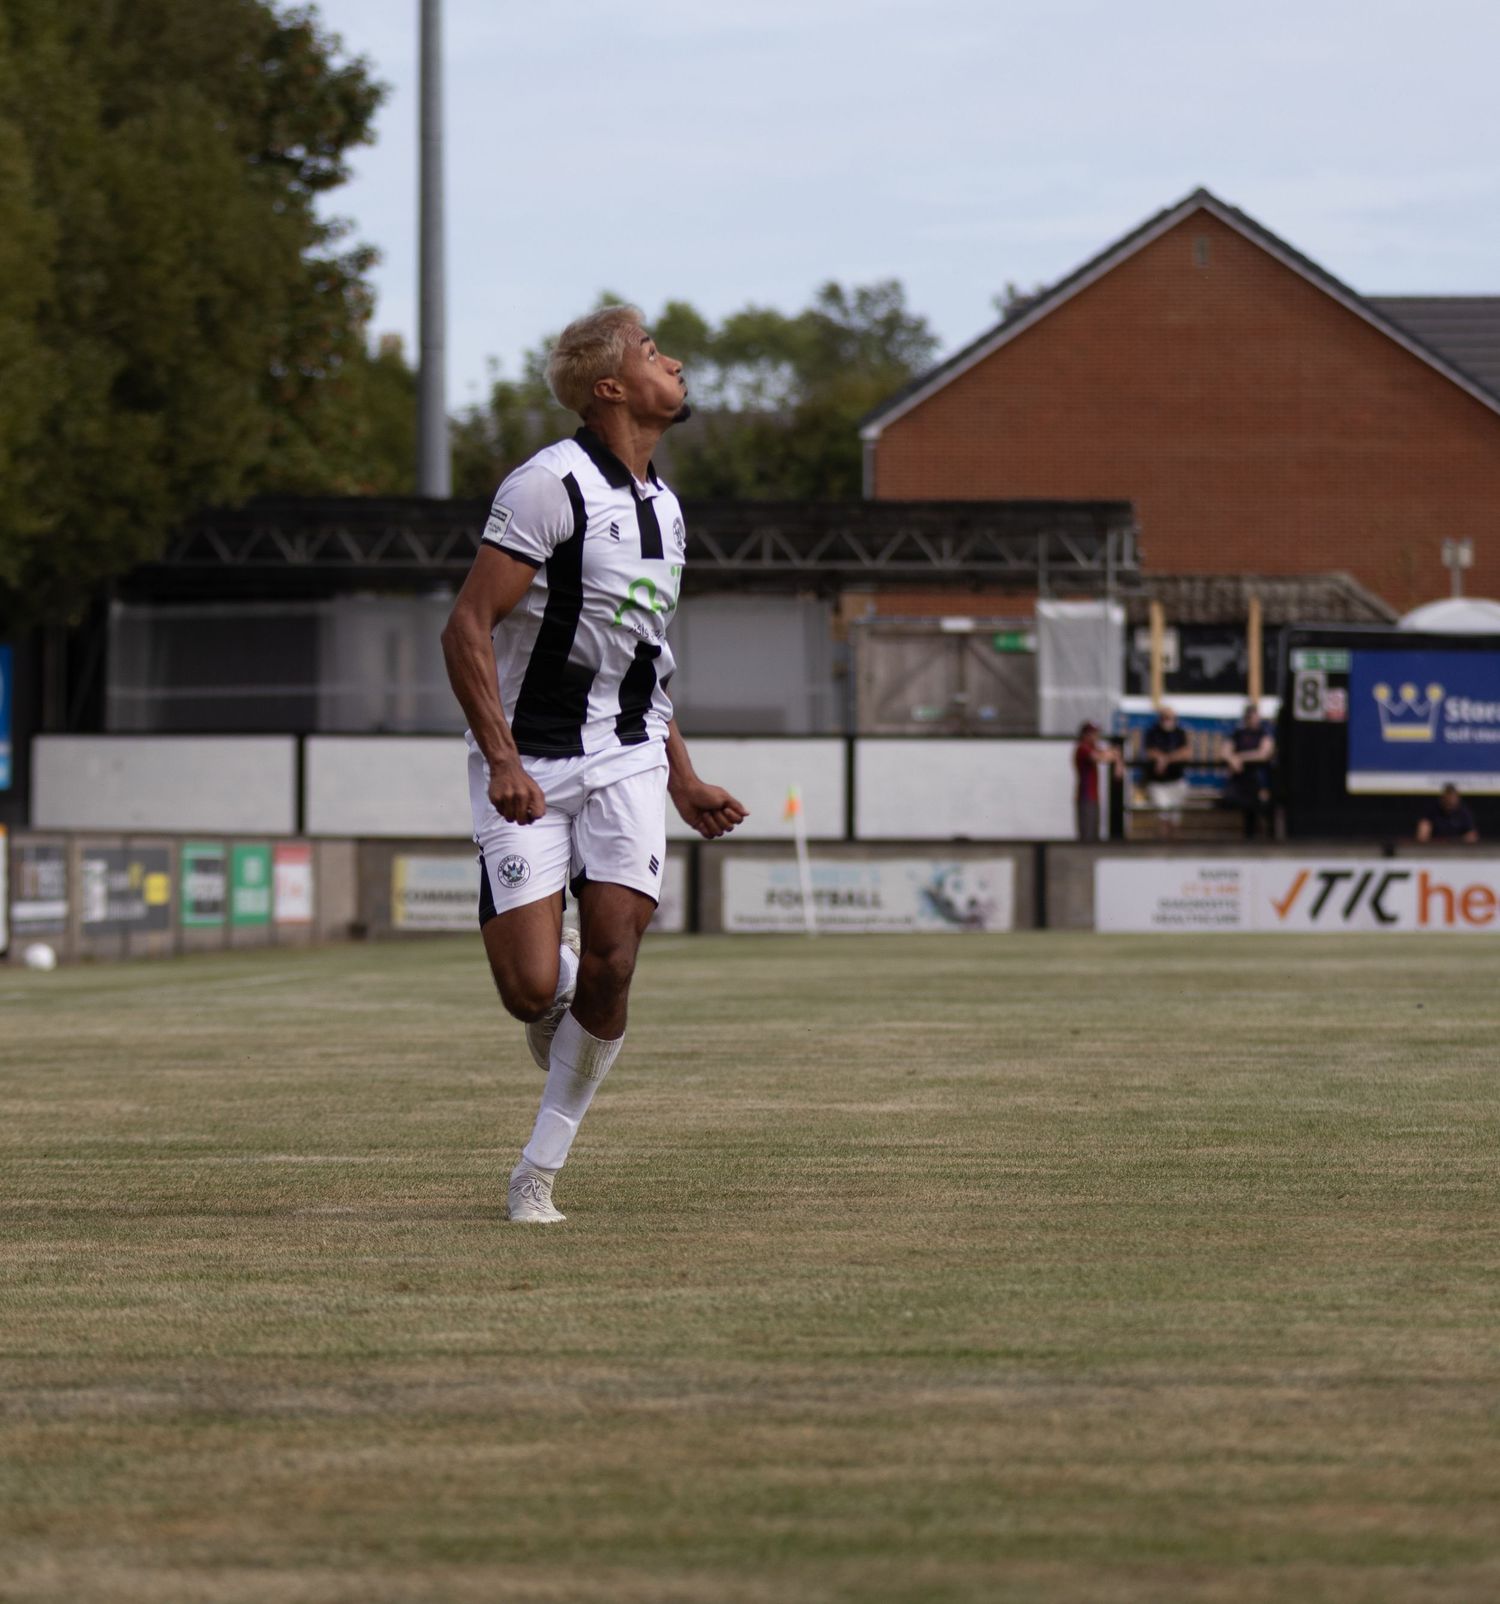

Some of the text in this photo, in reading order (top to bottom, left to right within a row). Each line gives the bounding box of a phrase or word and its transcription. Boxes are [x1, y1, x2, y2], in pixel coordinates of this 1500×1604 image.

[1302, 679, 1320, 711] 8
[1310, 869, 1497, 926] TIC he
